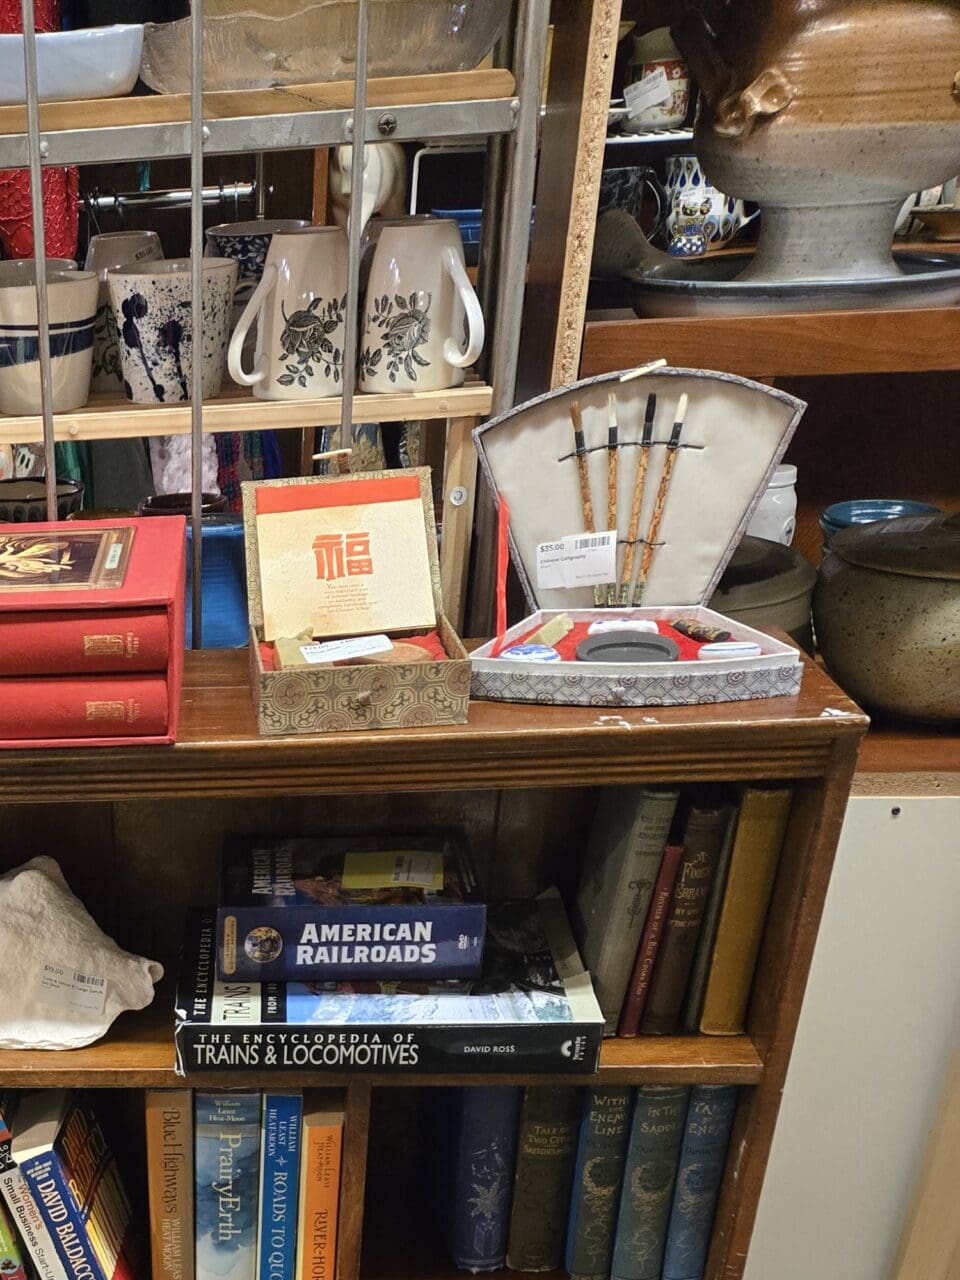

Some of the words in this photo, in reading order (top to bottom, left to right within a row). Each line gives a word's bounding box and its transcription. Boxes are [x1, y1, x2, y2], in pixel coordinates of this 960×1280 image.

[312, 532, 374, 580] 福
[540, 543, 564, 552] $35.00
[300, 920, 432, 944] AMERICAN
[195, 926, 212, 994] ENCYCLOPEDIA
[296, 943, 437, 966] RAILROADS
[193, 996, 207, 1016] THE
[222, 984, 252, 1021] TRAINS
[193, 1044, 258, 1066] TRAINS
[264, 1046, 278, 1065] &
[282, 1044, 419, 1066] LOCOMOTIVES
[199, 1034, 232, 1044] THE
[242, 1034, 381, 1044] ENCYCLOPEDIA
[393, 1034, 416, 1044] OF
[464, 1045, 490, 1054] DAVID
[492, 1044, 516, 1054] ROSS
[162, 1108, 182, 1145] Blue
[278, 1120, 287, 1146] LEAST
[288, 1114, 299, 1152] WILLIAM
[160, 1144, 183, 1213] Highways
[212, 1132, 242, 1242] PrairyErth
[4, 1176, 20, 1210] Small
[16, 1203, 38, 1248] Business
[19, 1182, 44, 1231] Women's
[38, 1178, 68, 1224] DAVID
[272, 1171, 288, 1224] ROADS
[271, 1227, 286, 1248] TO
